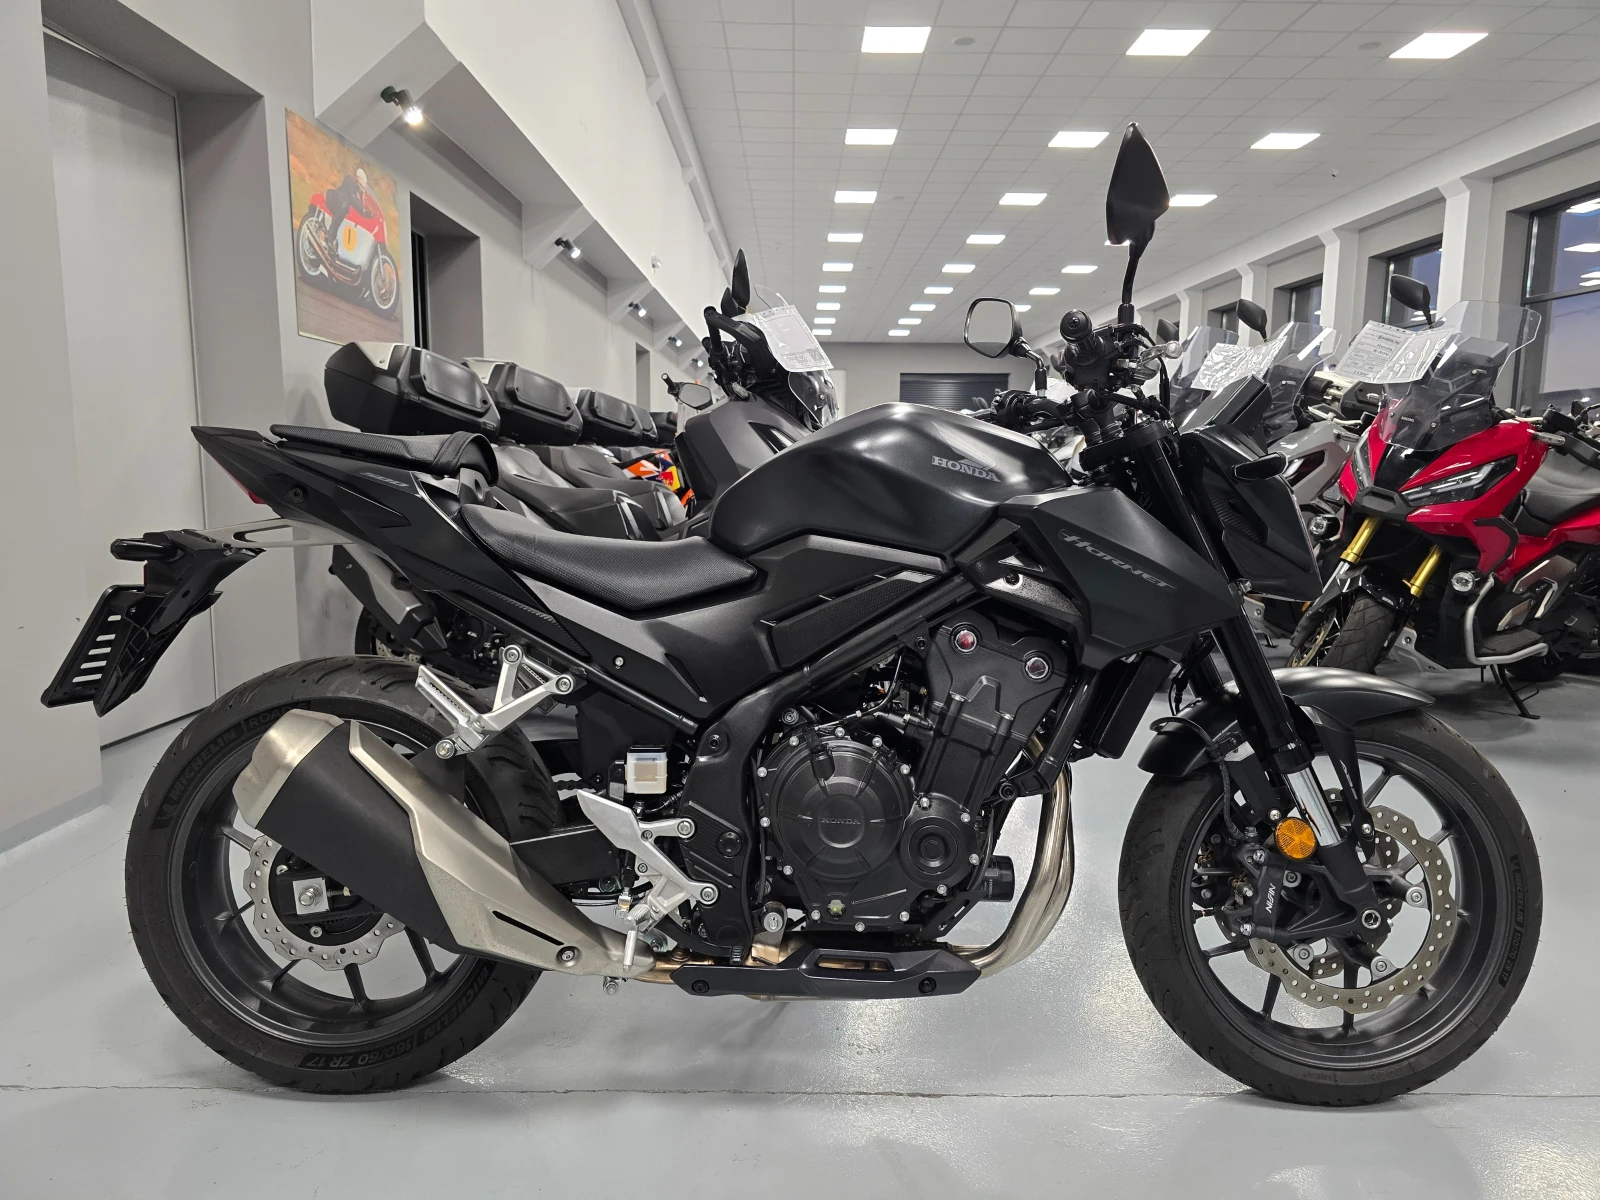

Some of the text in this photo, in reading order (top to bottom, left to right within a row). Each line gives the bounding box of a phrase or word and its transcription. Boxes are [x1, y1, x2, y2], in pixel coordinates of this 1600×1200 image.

[931, 455, 1001, 483] HONDA
[170, 728, 238, 801] MICHELIN
[820, 817, 861, 825] HONDA
[1501, 872, 1525, 981] MICHELIN 120/70 ZR 17
[306, 965, 490, 1068] MICHELIN 160/60 ZR 17
